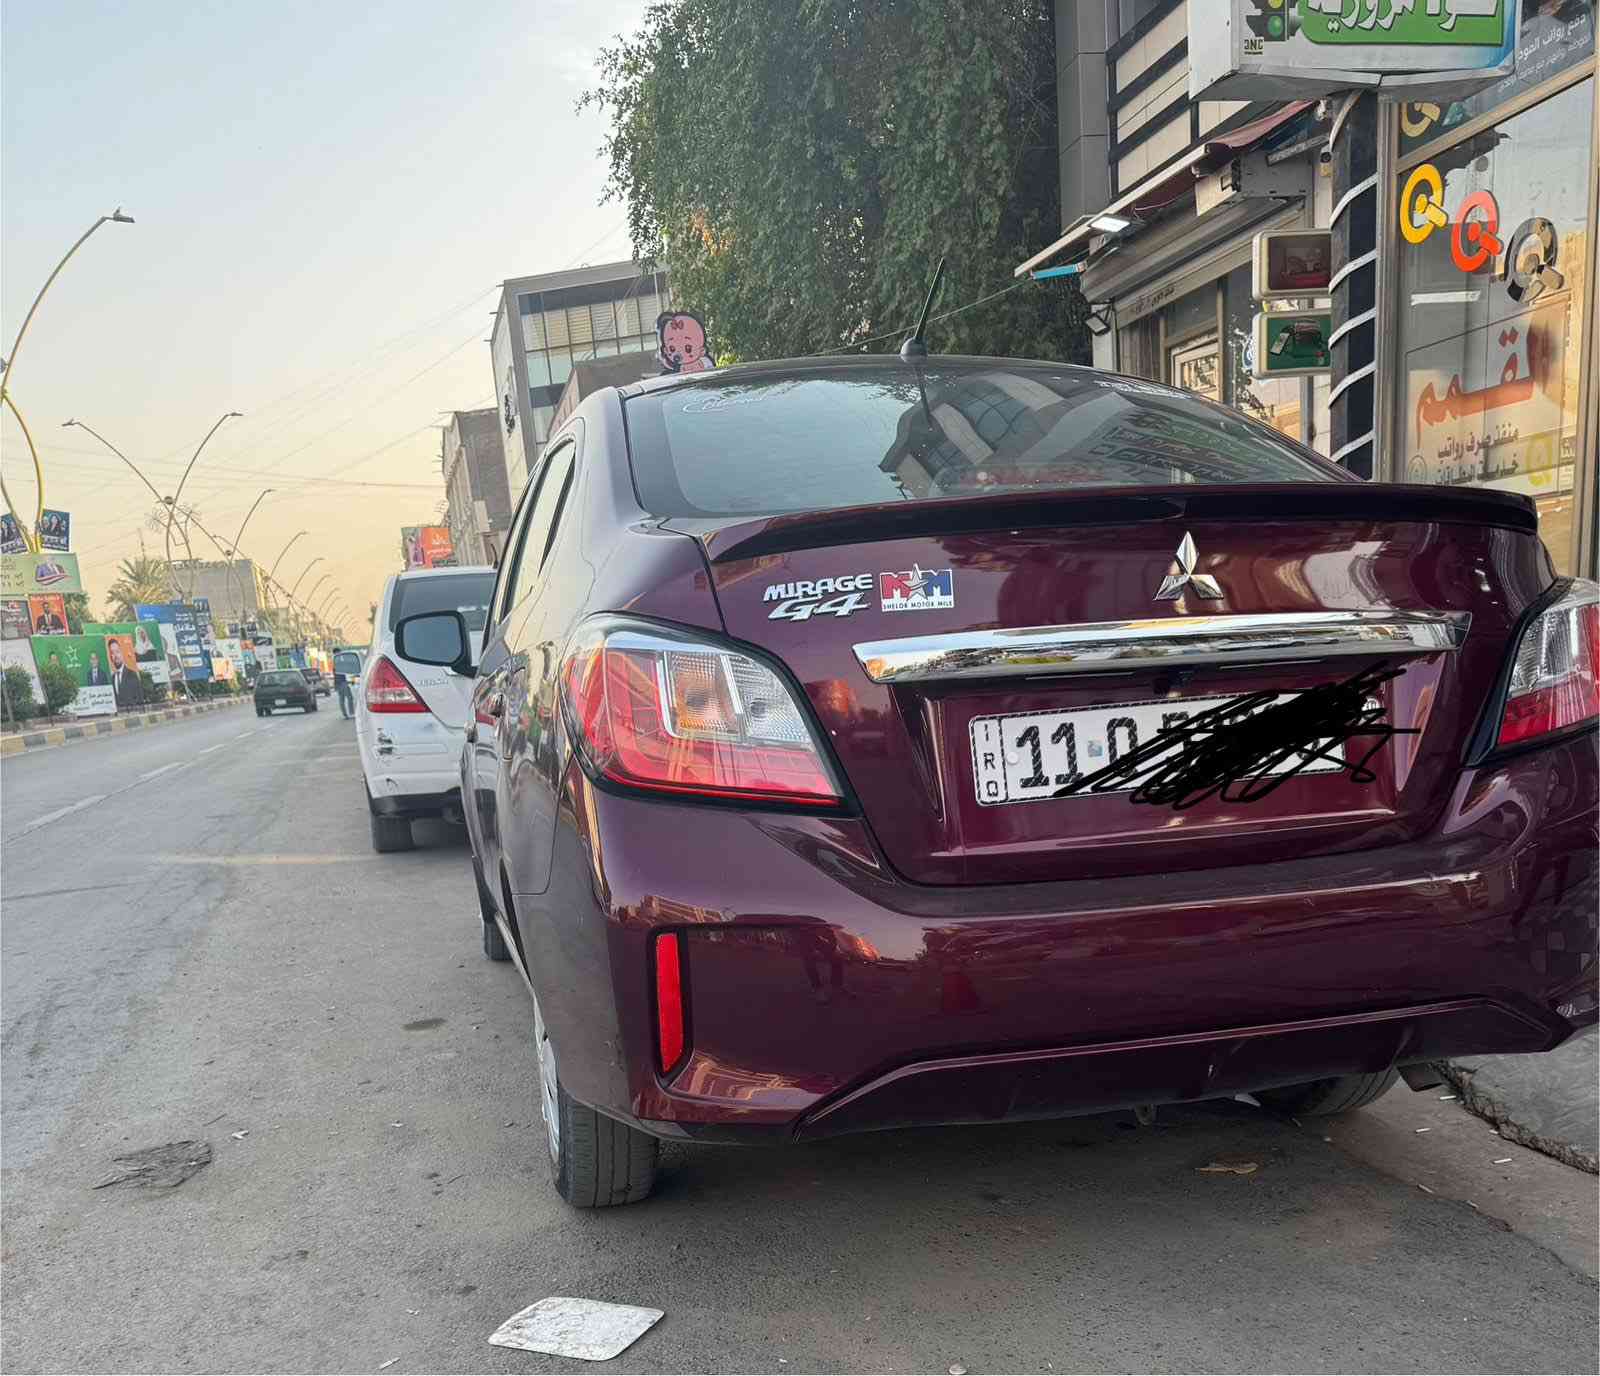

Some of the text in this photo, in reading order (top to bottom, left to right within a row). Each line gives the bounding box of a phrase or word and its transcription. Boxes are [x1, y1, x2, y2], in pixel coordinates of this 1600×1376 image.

[763, 573, 873, 601] MIRAGE
[768, 592, 871, 622] G4
[911, 601, 934, 609] MOTOR
[937, 600, 952, 608] MILE
[1016, 722, 1083, 788] 11
